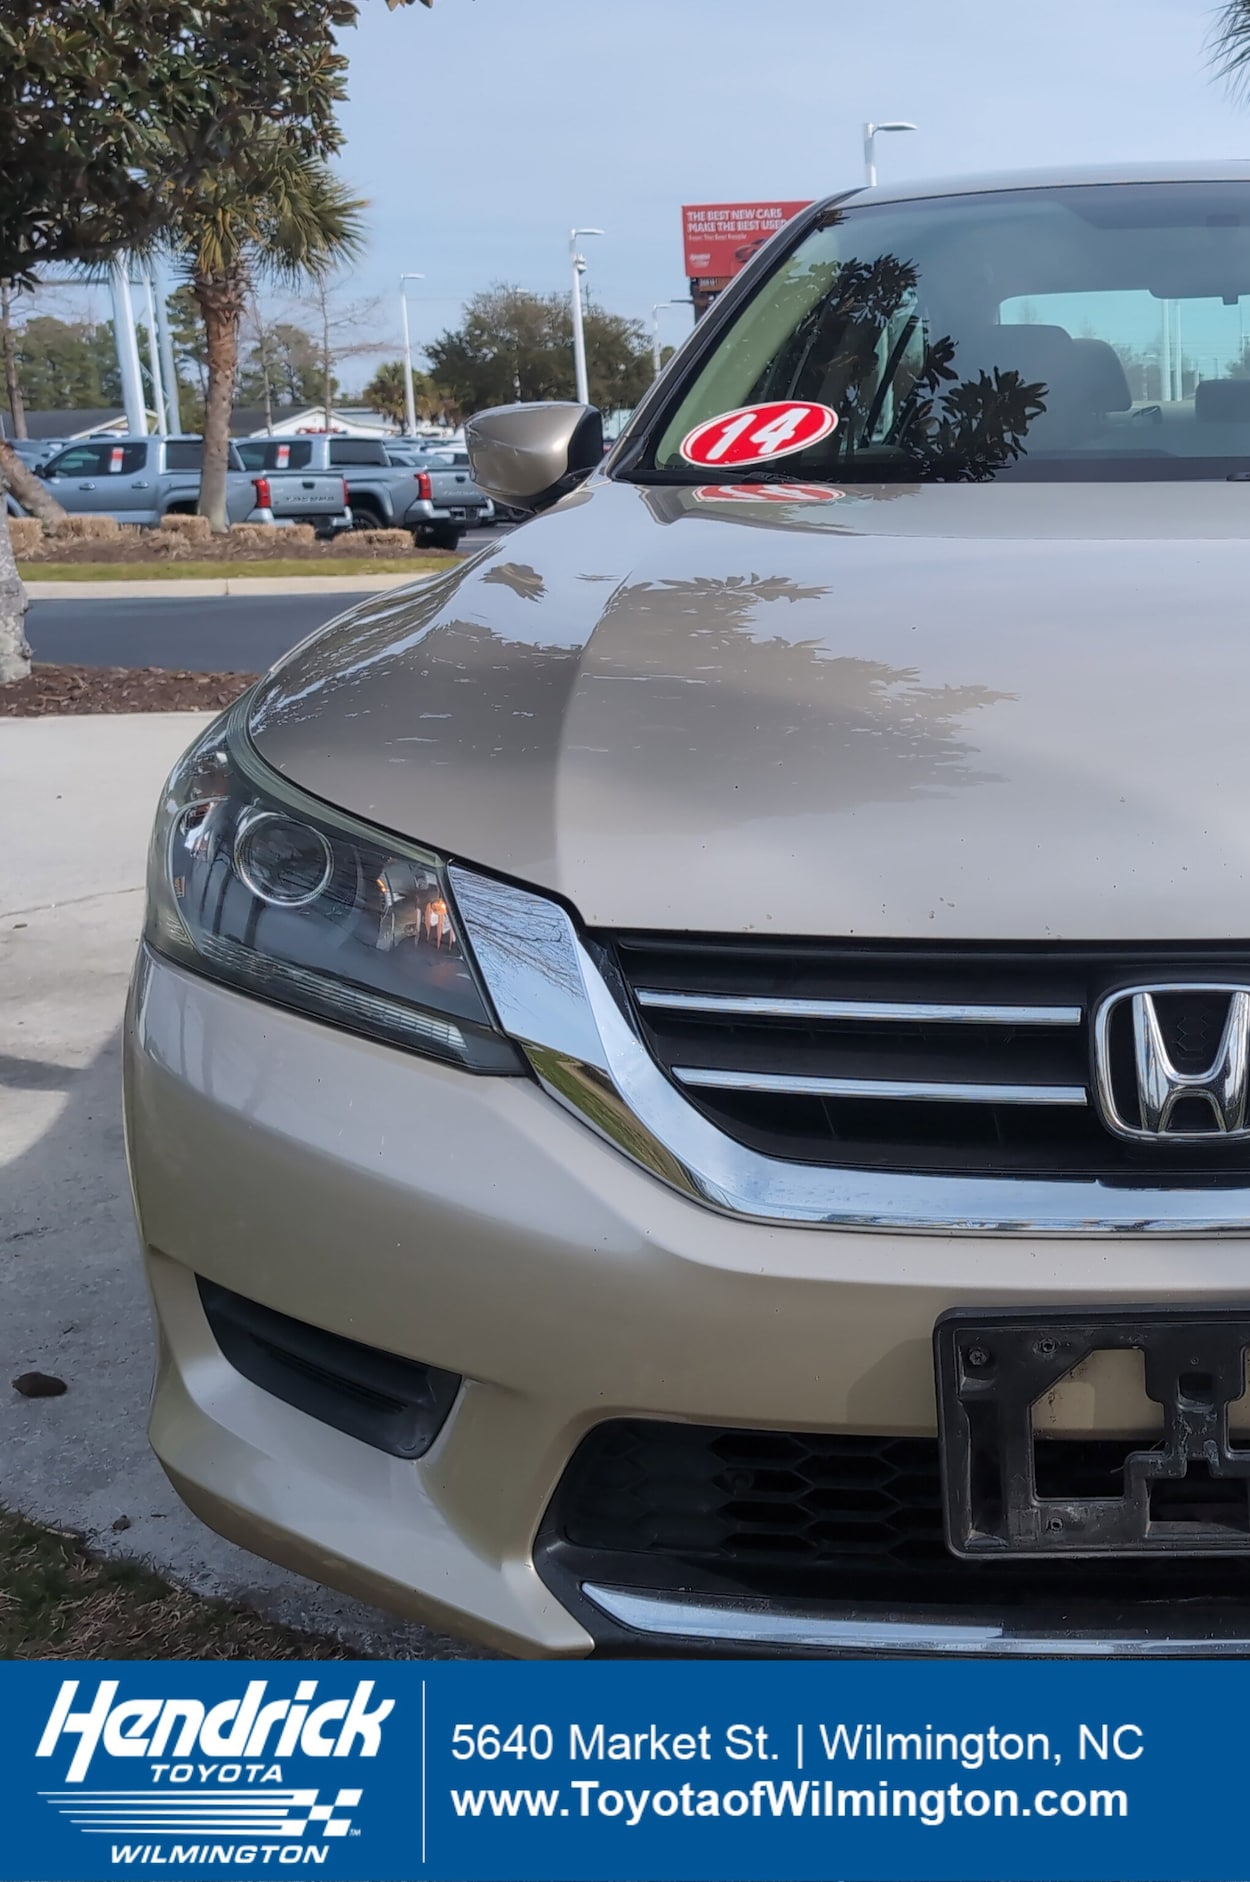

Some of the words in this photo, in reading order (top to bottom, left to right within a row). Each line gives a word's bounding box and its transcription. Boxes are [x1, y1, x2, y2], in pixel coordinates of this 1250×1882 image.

[687, 211, 706, 222] THE
[707, 210, 731, 221] BEST
[732, 209, 756, 220] NEW
[756, 208, 782, 219] CARS
[688, 222, 717, 233] MAKE
[717, 221, 737, 232] THE
[737, 220, 761, 231] BEST
[705, 408, 811, 461] 14
